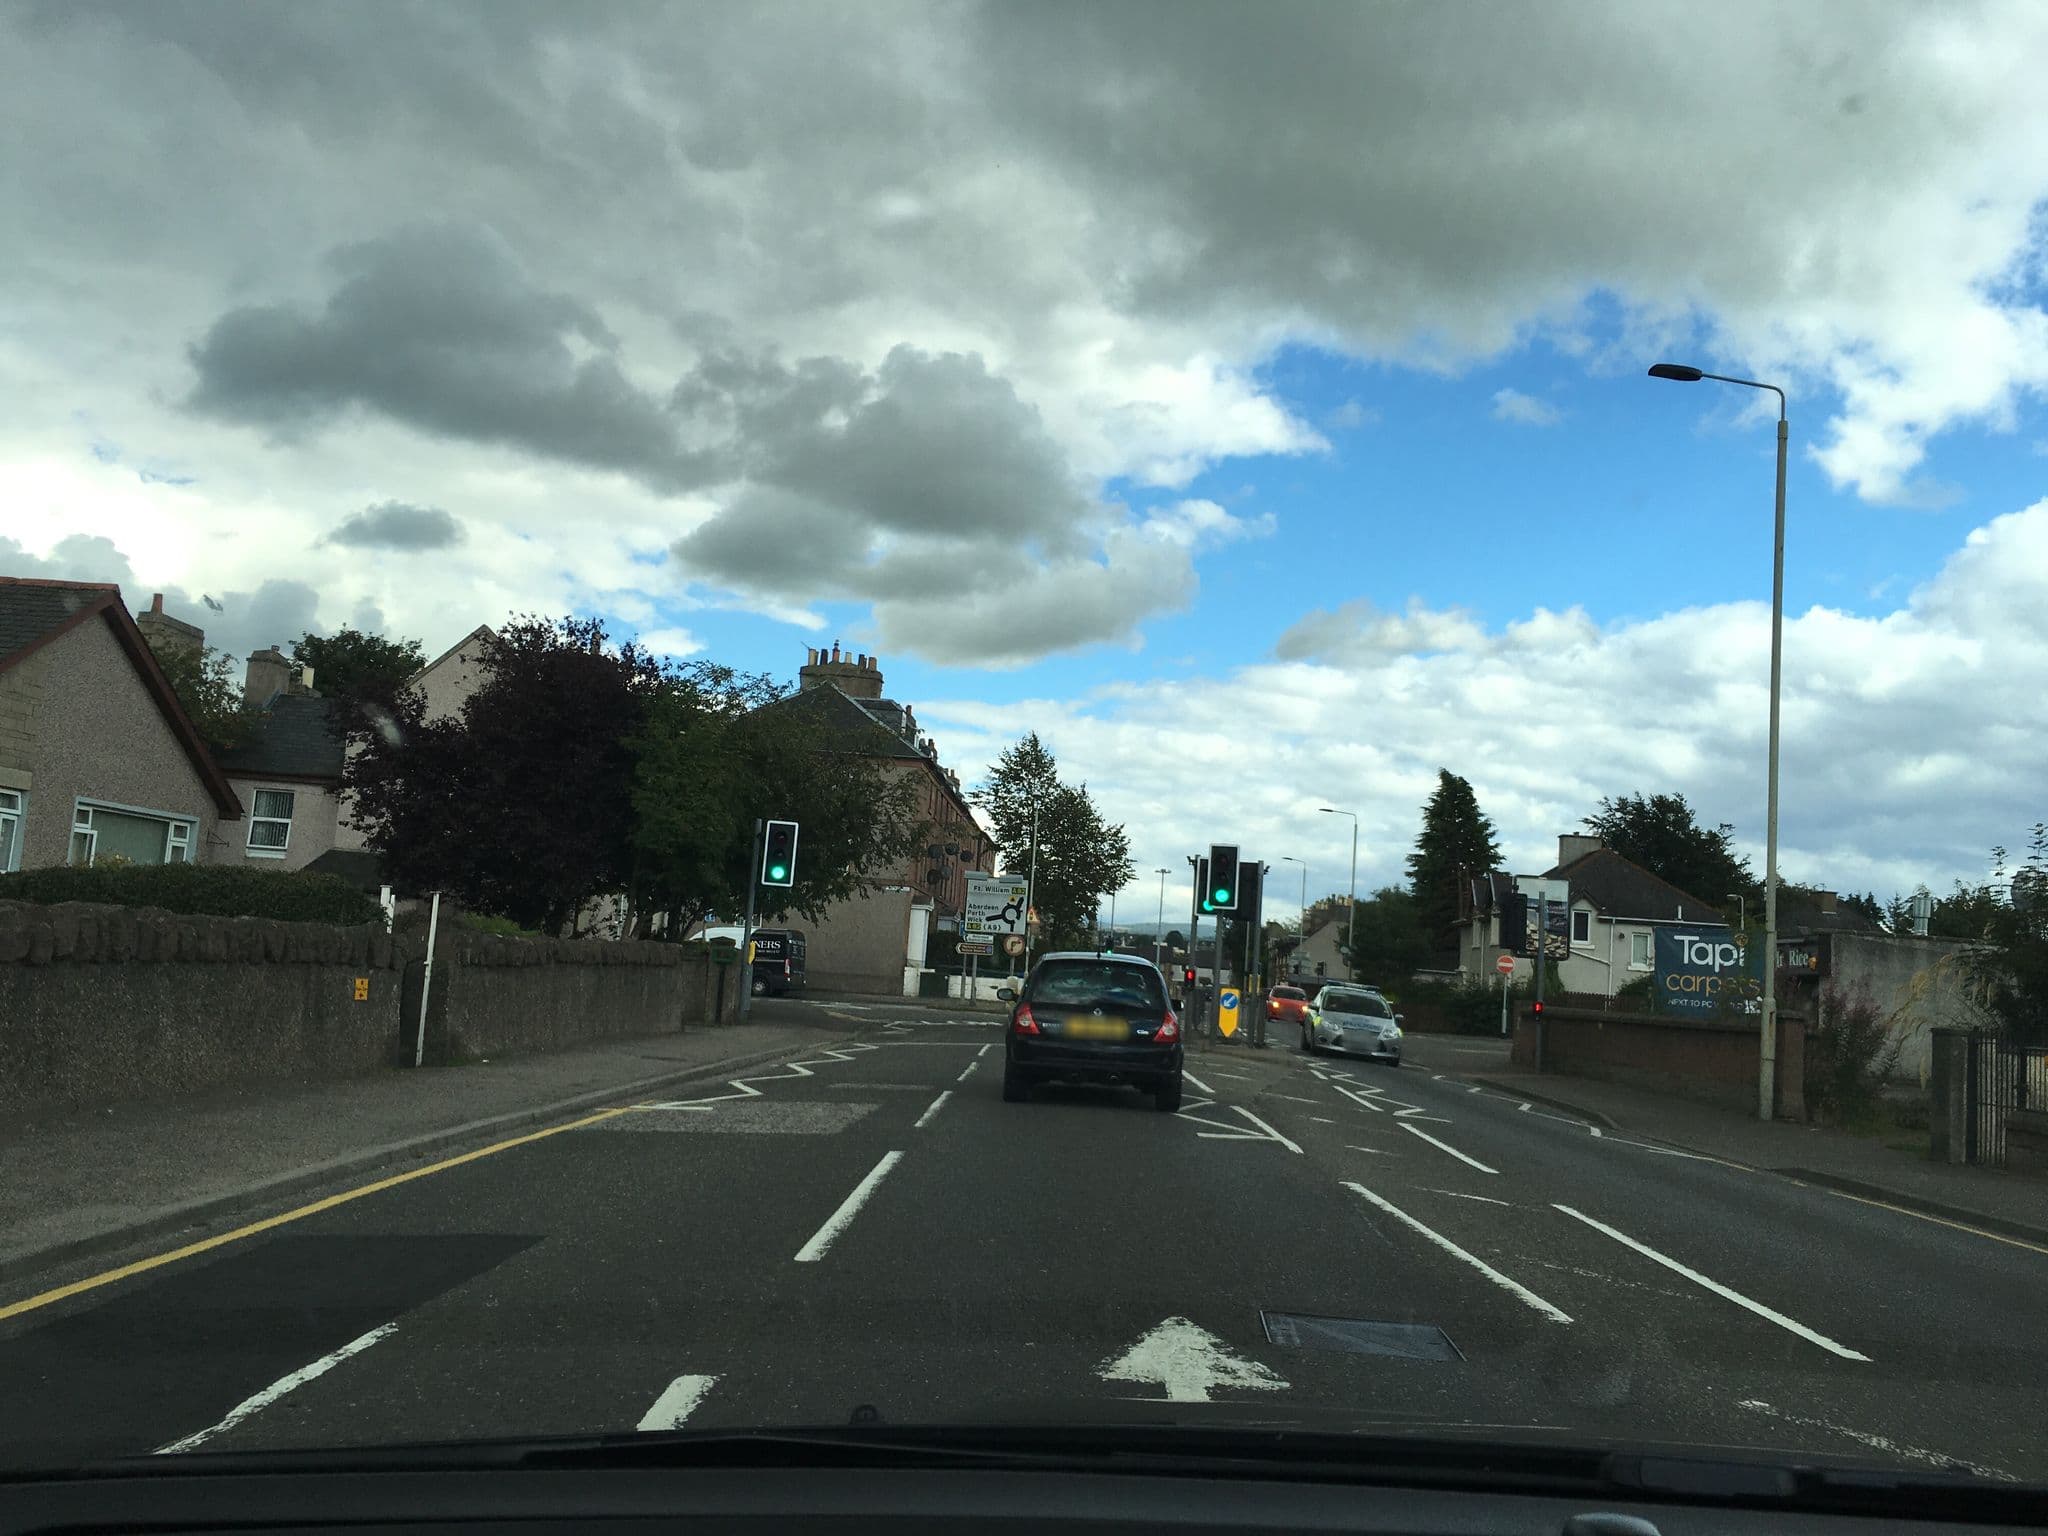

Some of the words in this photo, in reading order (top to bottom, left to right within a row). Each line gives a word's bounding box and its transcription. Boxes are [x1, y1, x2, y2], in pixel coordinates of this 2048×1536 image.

[985, 886, 1010, 894] William
[1789, 949, 1809, 966] Rice
[1667, 998, 1689, 1006] NEXT
[1690, 999, 1701, 1007] TO
